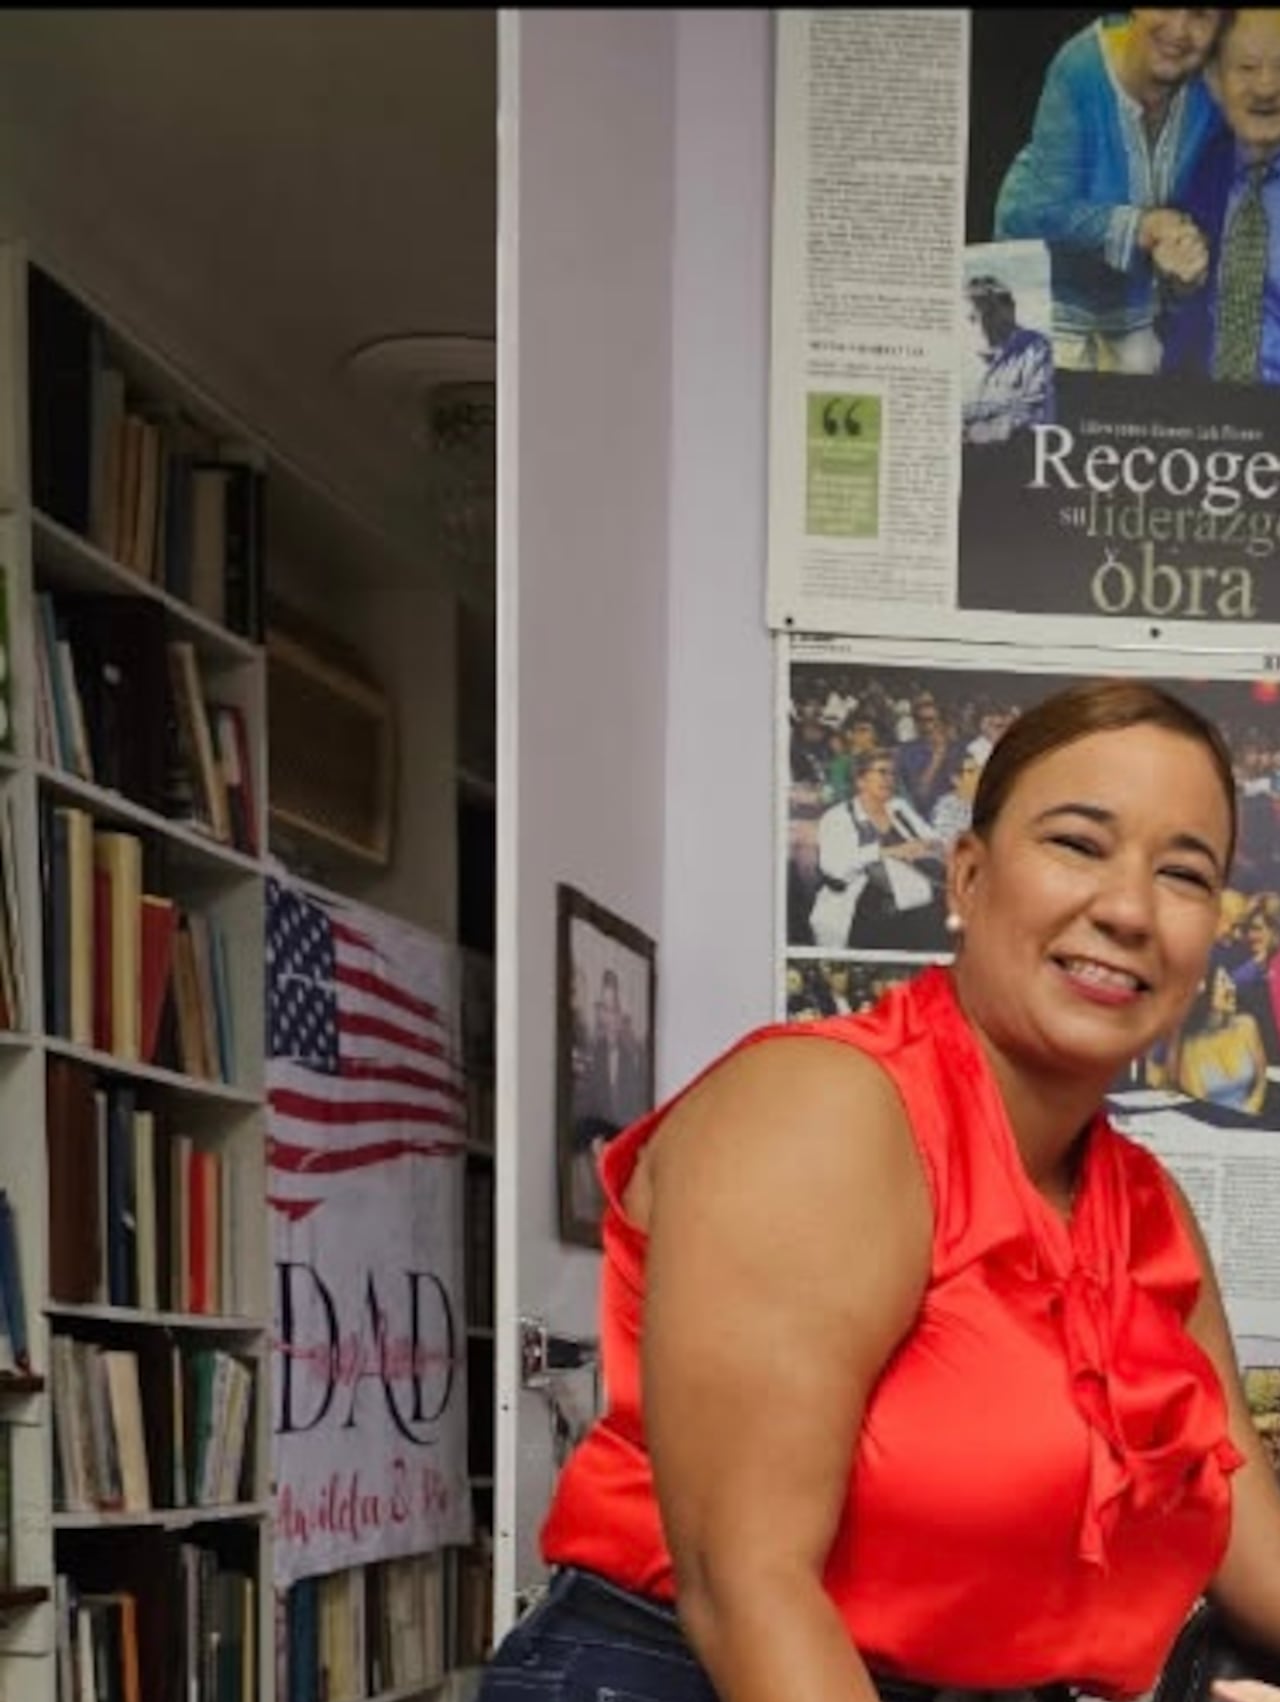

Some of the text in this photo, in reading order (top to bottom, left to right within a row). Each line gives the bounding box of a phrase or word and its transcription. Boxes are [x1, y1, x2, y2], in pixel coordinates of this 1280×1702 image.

[1059, 506, 1086, 526] su
[1091, 541, 1258, 619] obra
[275, 1262, 455, 1445] DAD
